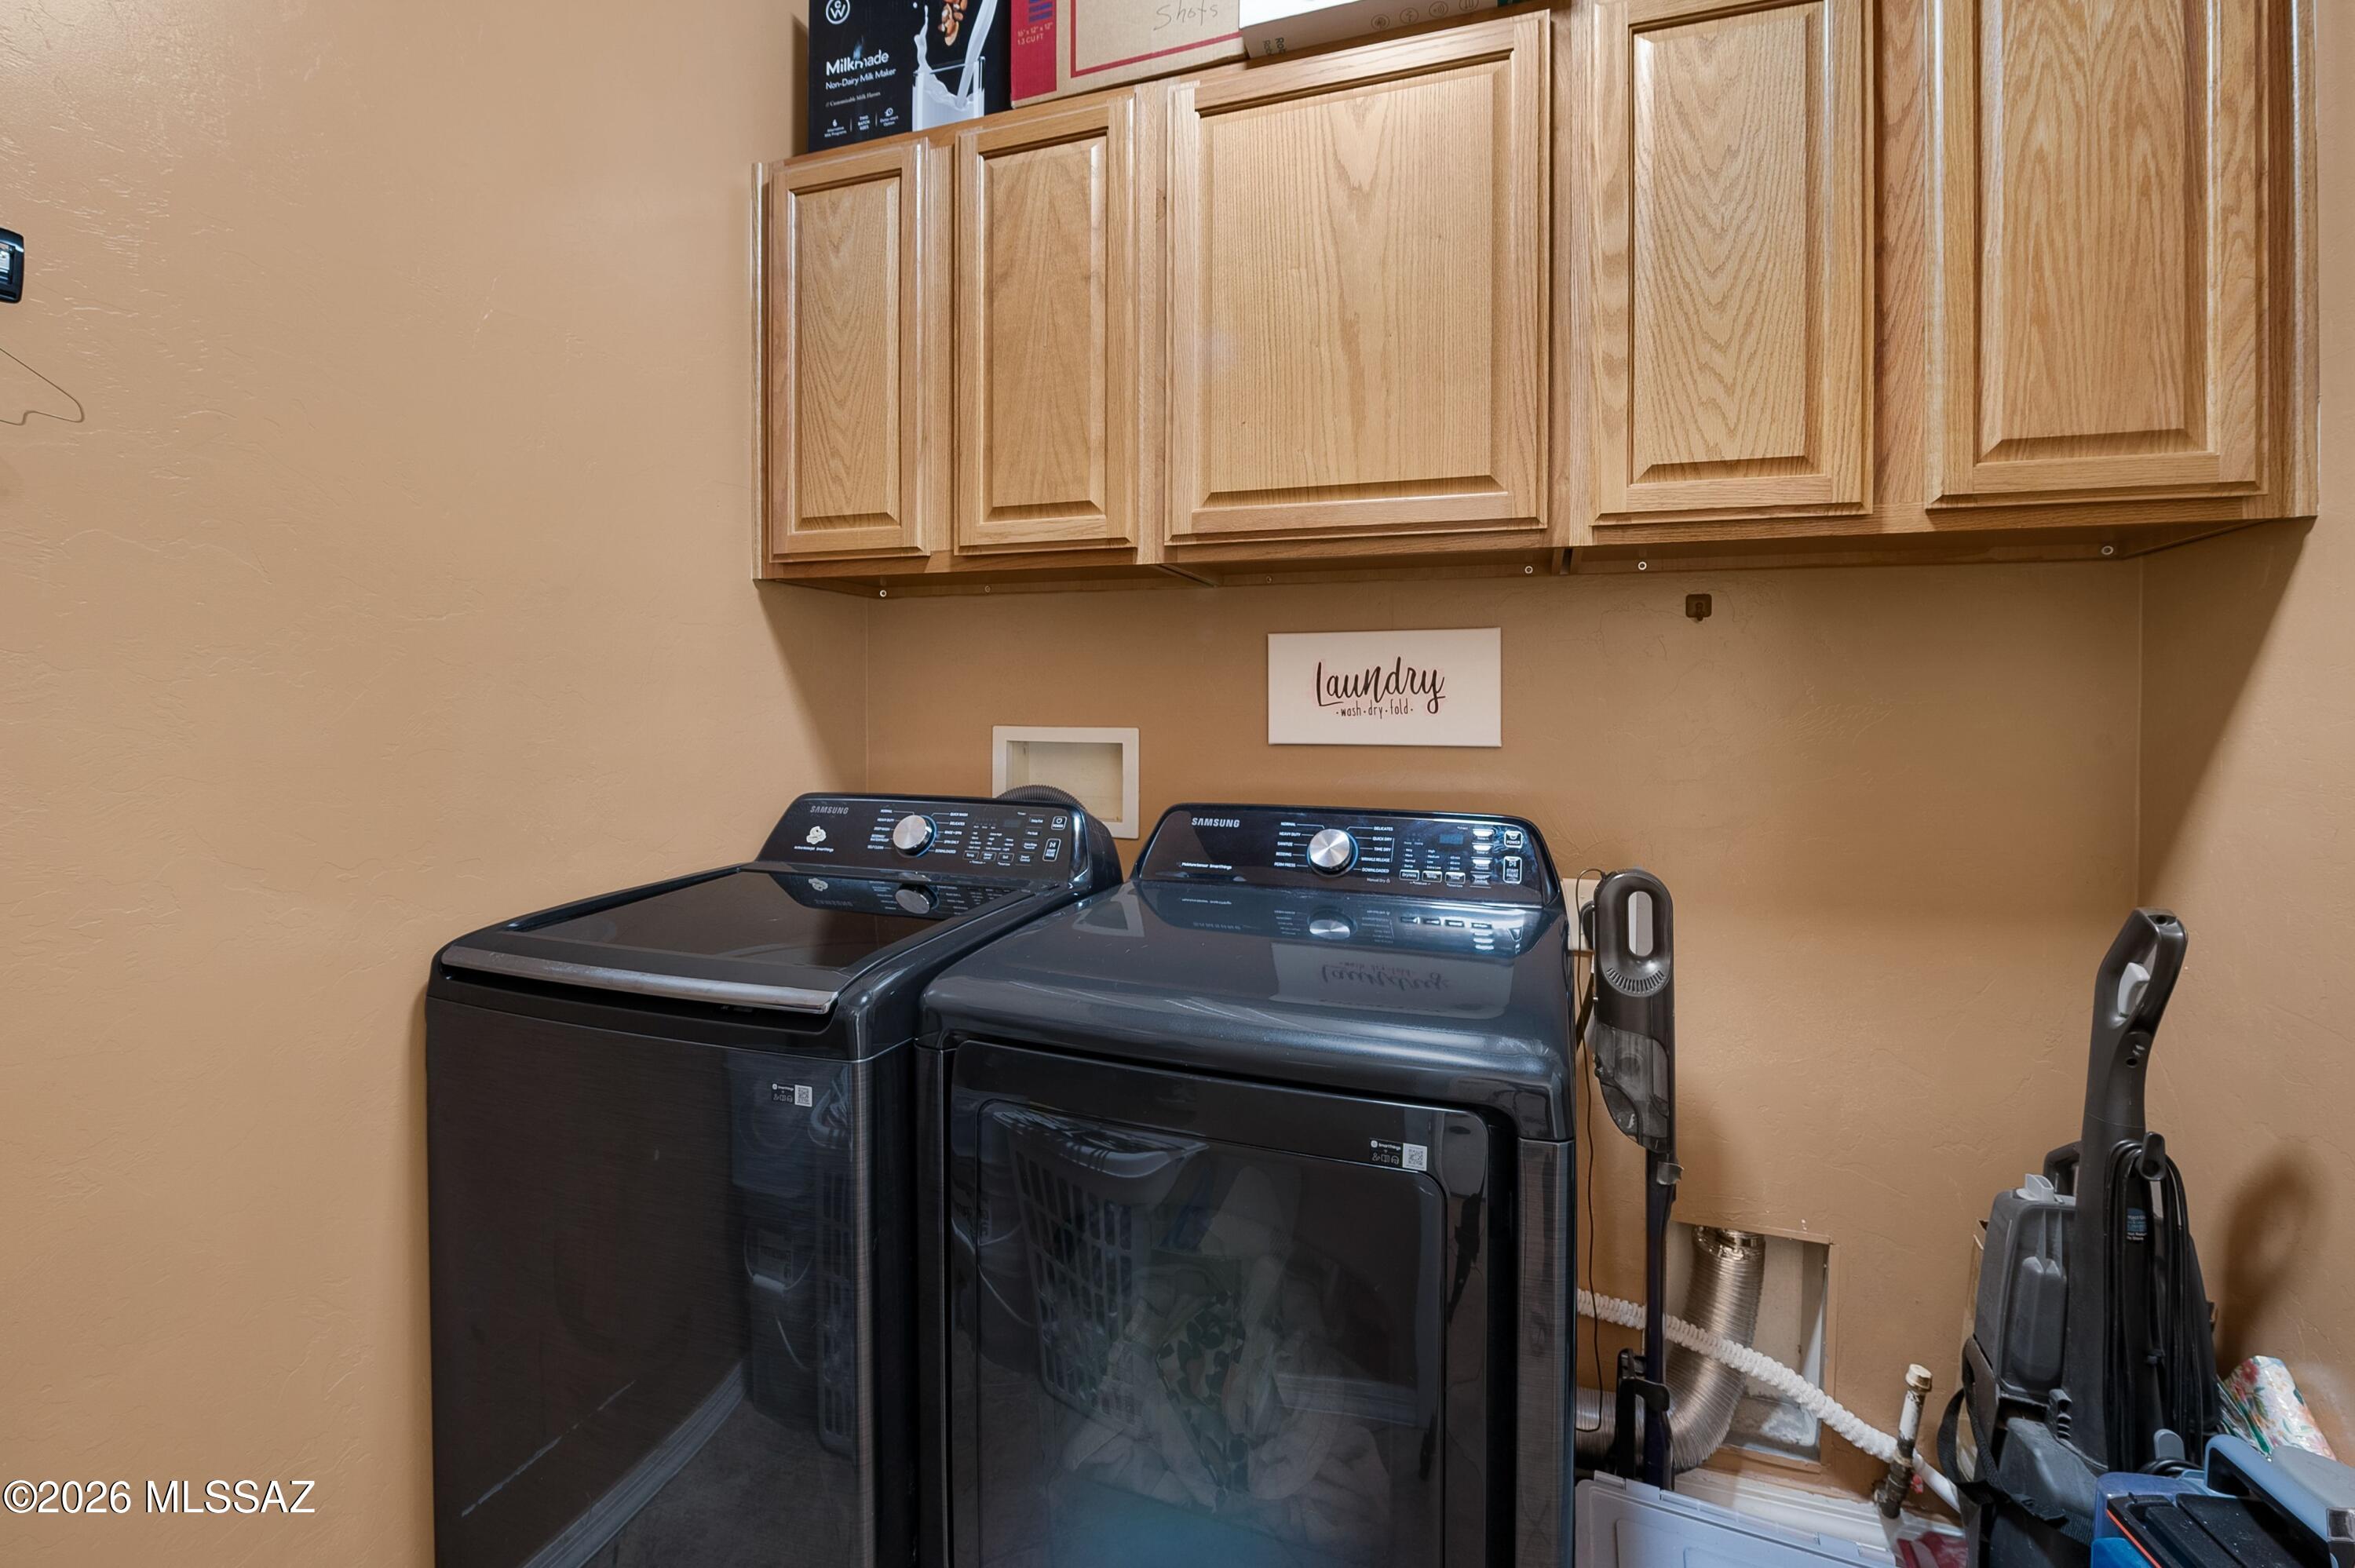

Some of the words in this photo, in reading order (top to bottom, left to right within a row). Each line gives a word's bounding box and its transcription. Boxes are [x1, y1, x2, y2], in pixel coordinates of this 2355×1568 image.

[826, 49, 889, 76] Milkmade
[825, 77, 860, 90] Non-Dairy
[860, 71, 874, 82] Milk
[874, 68, 896, 79] Maker
[1316, 655, 1446, 715] Laundry
[1341, 700, 1362, 717] wash
[1367, 699, 1382, 719] dry
[1390, 698, 1408, 716] fold
[809, 805, 849, 815] SAMSUNG
[1191, 817, 1240, 828] SAMSUNG
[1378, 1142, 1401, 1151] SmartThings
